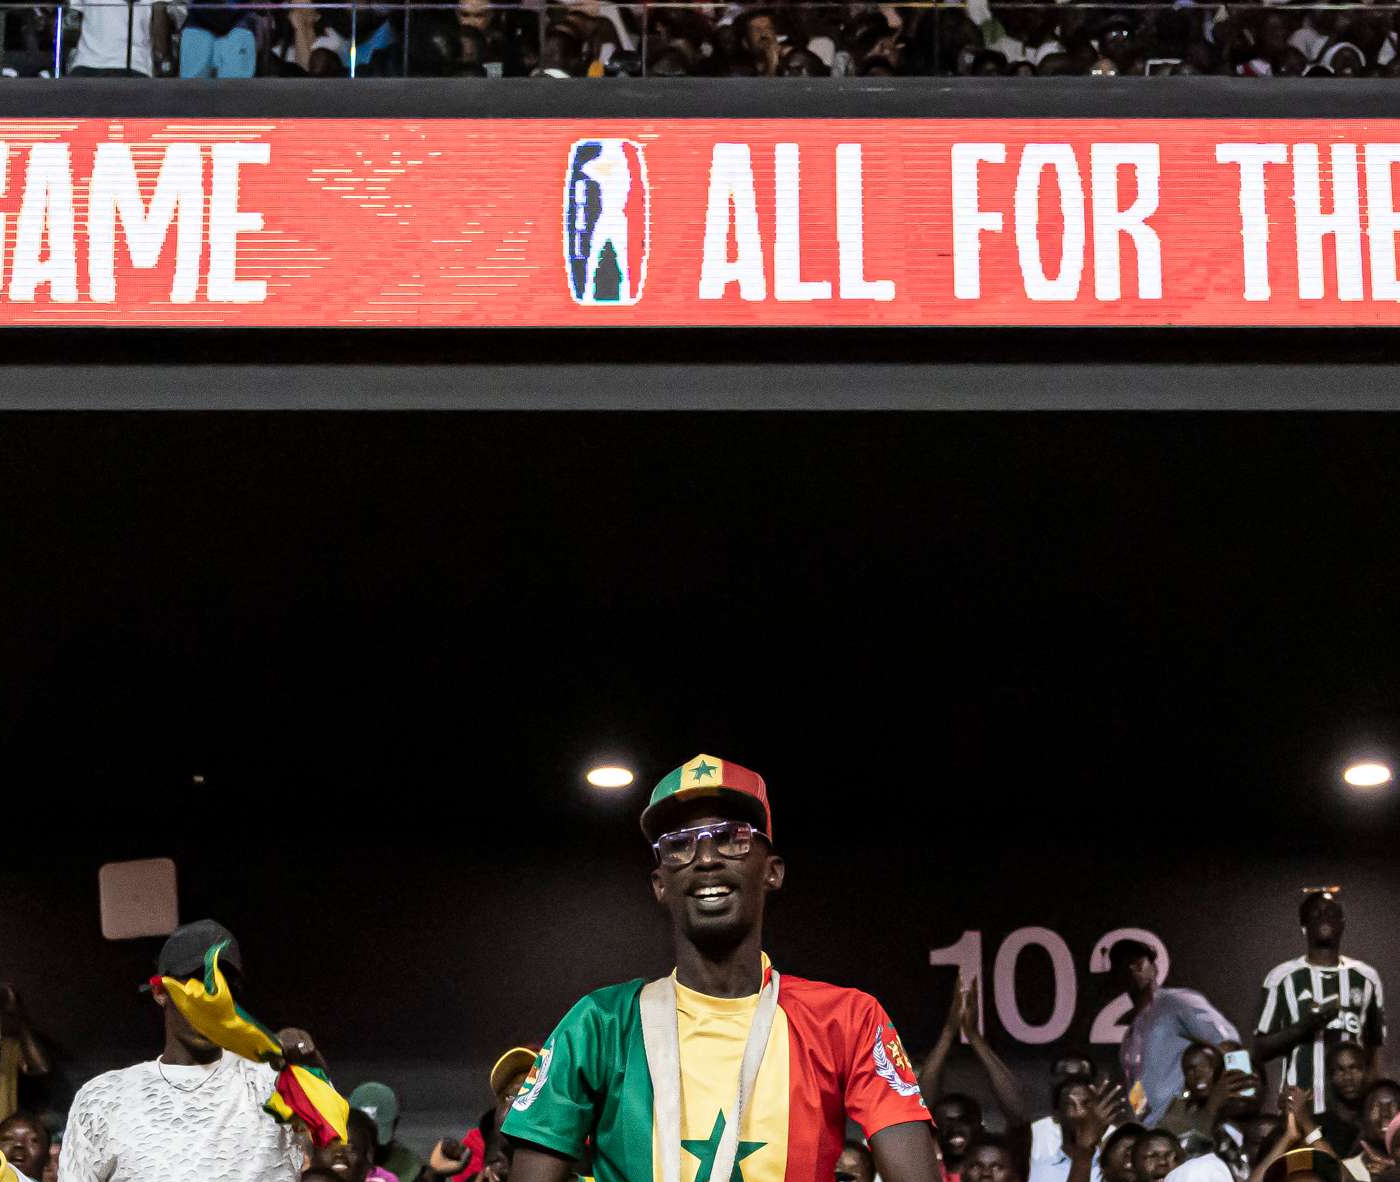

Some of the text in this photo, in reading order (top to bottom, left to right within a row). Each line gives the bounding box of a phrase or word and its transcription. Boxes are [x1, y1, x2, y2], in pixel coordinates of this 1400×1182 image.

[699, 143, 896, 301] ALL
[950, 143, 1163, 301] FOR
[930, 926, 1169, 1044] 102
